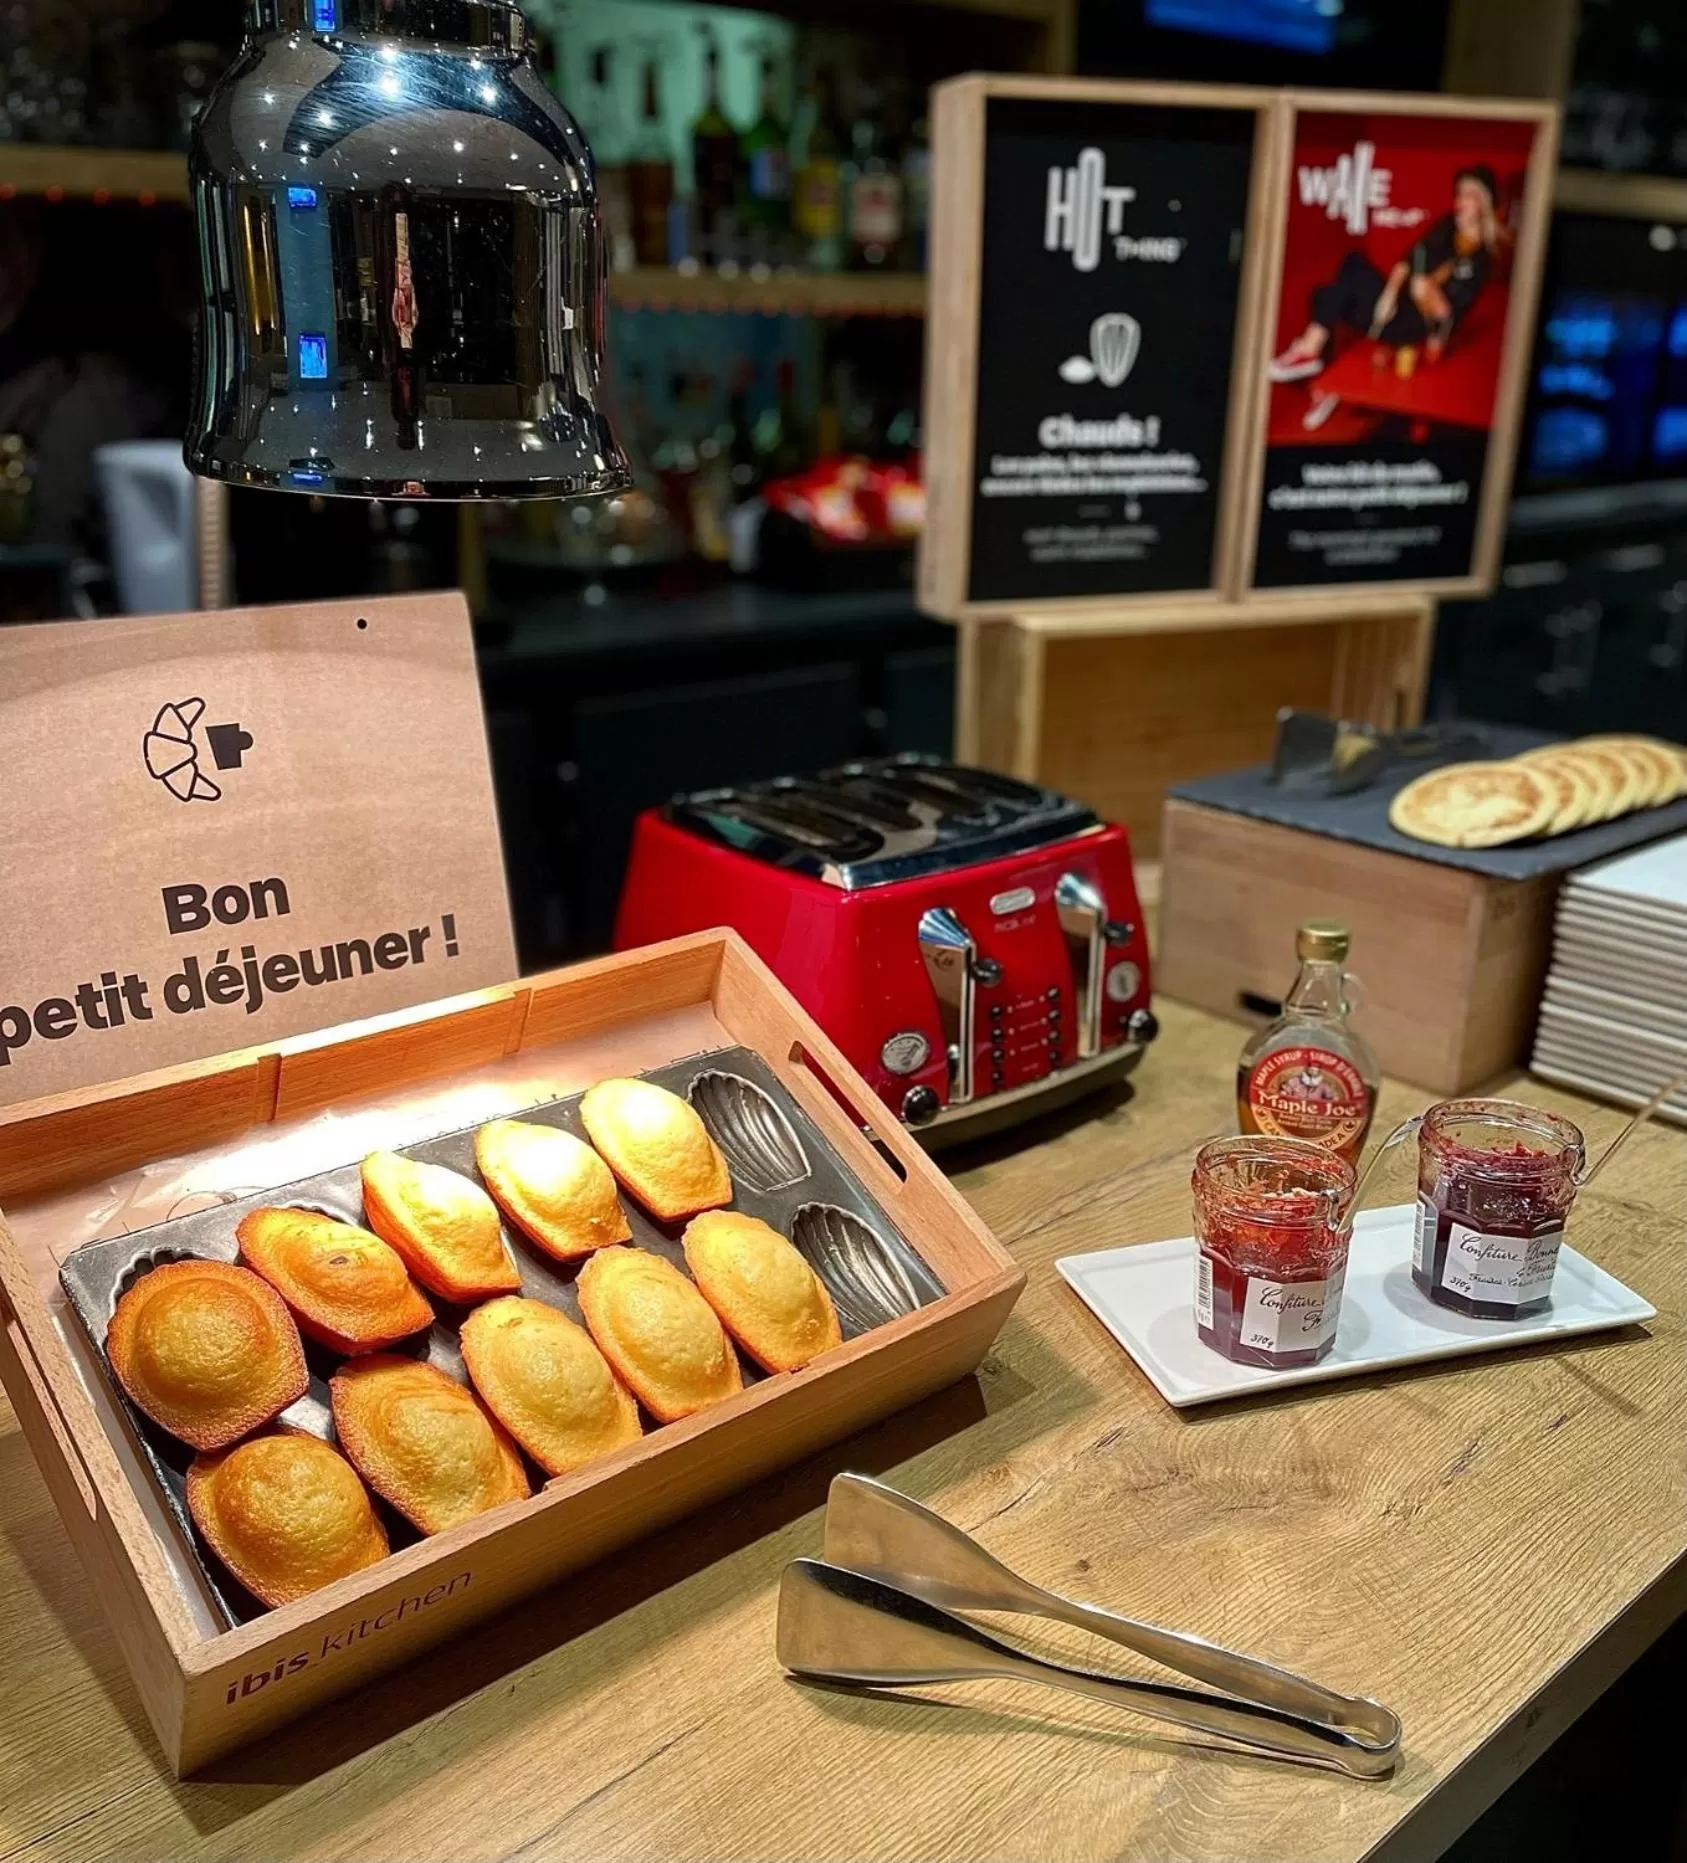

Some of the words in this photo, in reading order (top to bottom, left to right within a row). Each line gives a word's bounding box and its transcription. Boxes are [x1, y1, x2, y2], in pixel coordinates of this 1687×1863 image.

[1044, 147, 1136, 273] HOT
[161, 877, 291, 935] Bon
[0, 971, 153, 1067] petit
[163, 926, 431, 1015] déjeuner
[441, 914, 459, 957] !
[1257, 1089, 1319, 1114] Maple
[1460, 1233, 1522, 1262] Confiture
[1259, 1286, 1321, 1315] Confiture
[226, 1651, 309, 1705] ibis
[320, 1572, 472, 1658] kitchen
